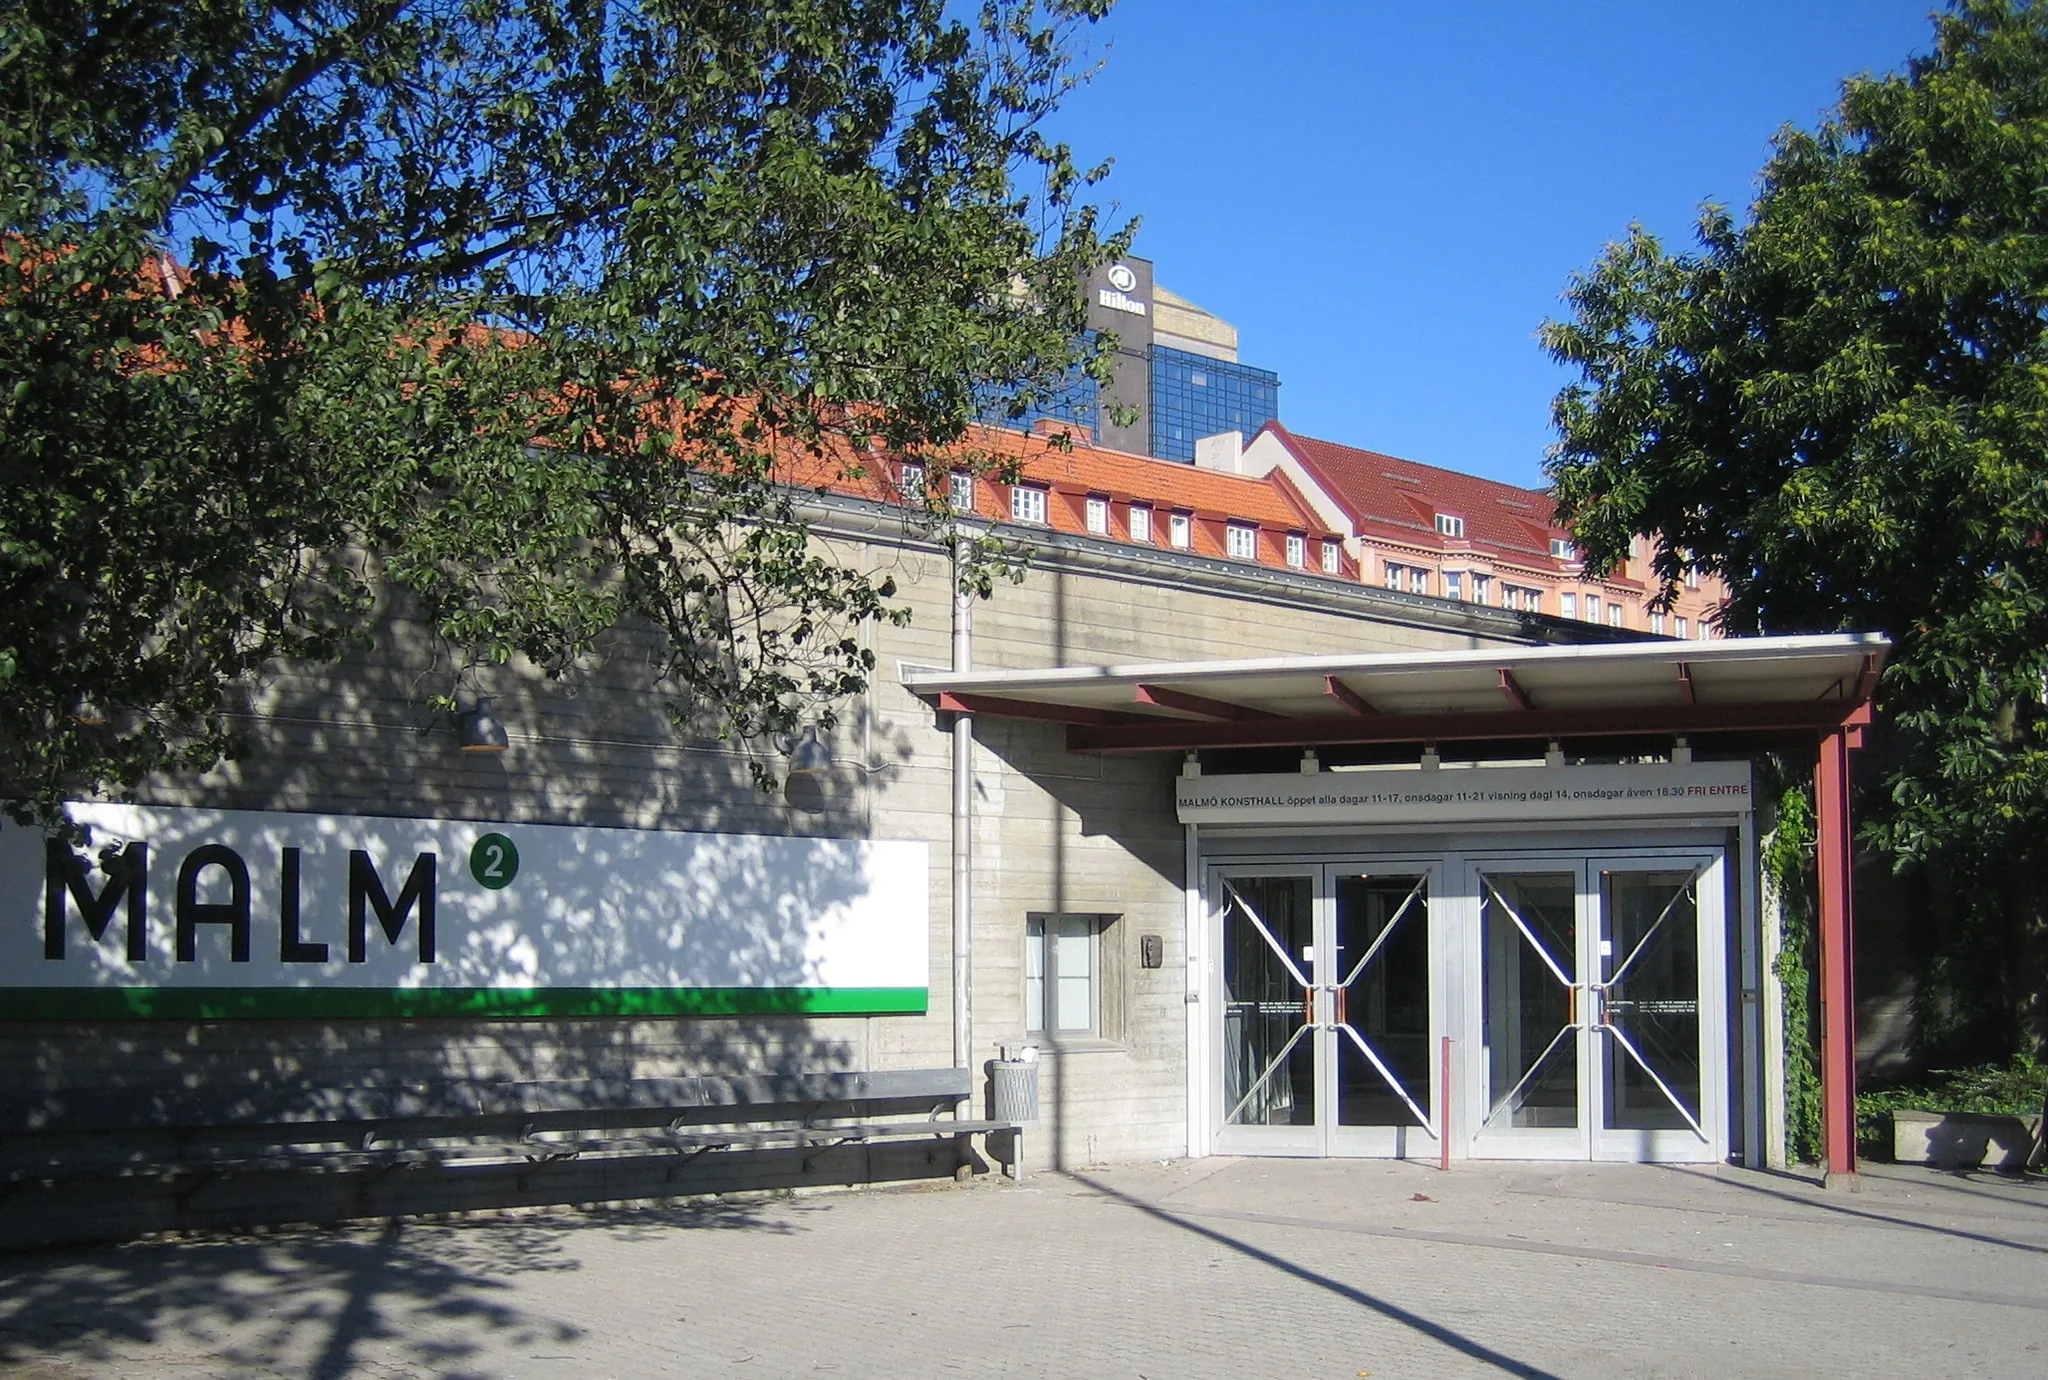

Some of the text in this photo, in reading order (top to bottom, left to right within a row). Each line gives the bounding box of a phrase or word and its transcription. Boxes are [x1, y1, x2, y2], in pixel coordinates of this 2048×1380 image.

[1098, 289, 1146, 317] Hilton
[1179, 796, 1218, 807] MALMÖ
[1220, 796, 1285, 806] KONSTHALL
[1287, 795, 1316, 807] öppet
[1318, 795, 1337, 805] alla
[1339, 794, 1368, 805] dagar
[1372, 793, 1402, 804] 11-17,
[1404, 793, 1453, 803] onsdagar
[1456, 792, 1484, 801] 11-21
[1488, 791, 1526, 802] visning
[1555, 789, 1571, 800] 14,
[1573, 788, 1623, 800] onsdagar
[1626, 787, 1652, 797] även
[1687, 786, 1706, 796] FRI
[45, 837, 504, 963] MALM 2
